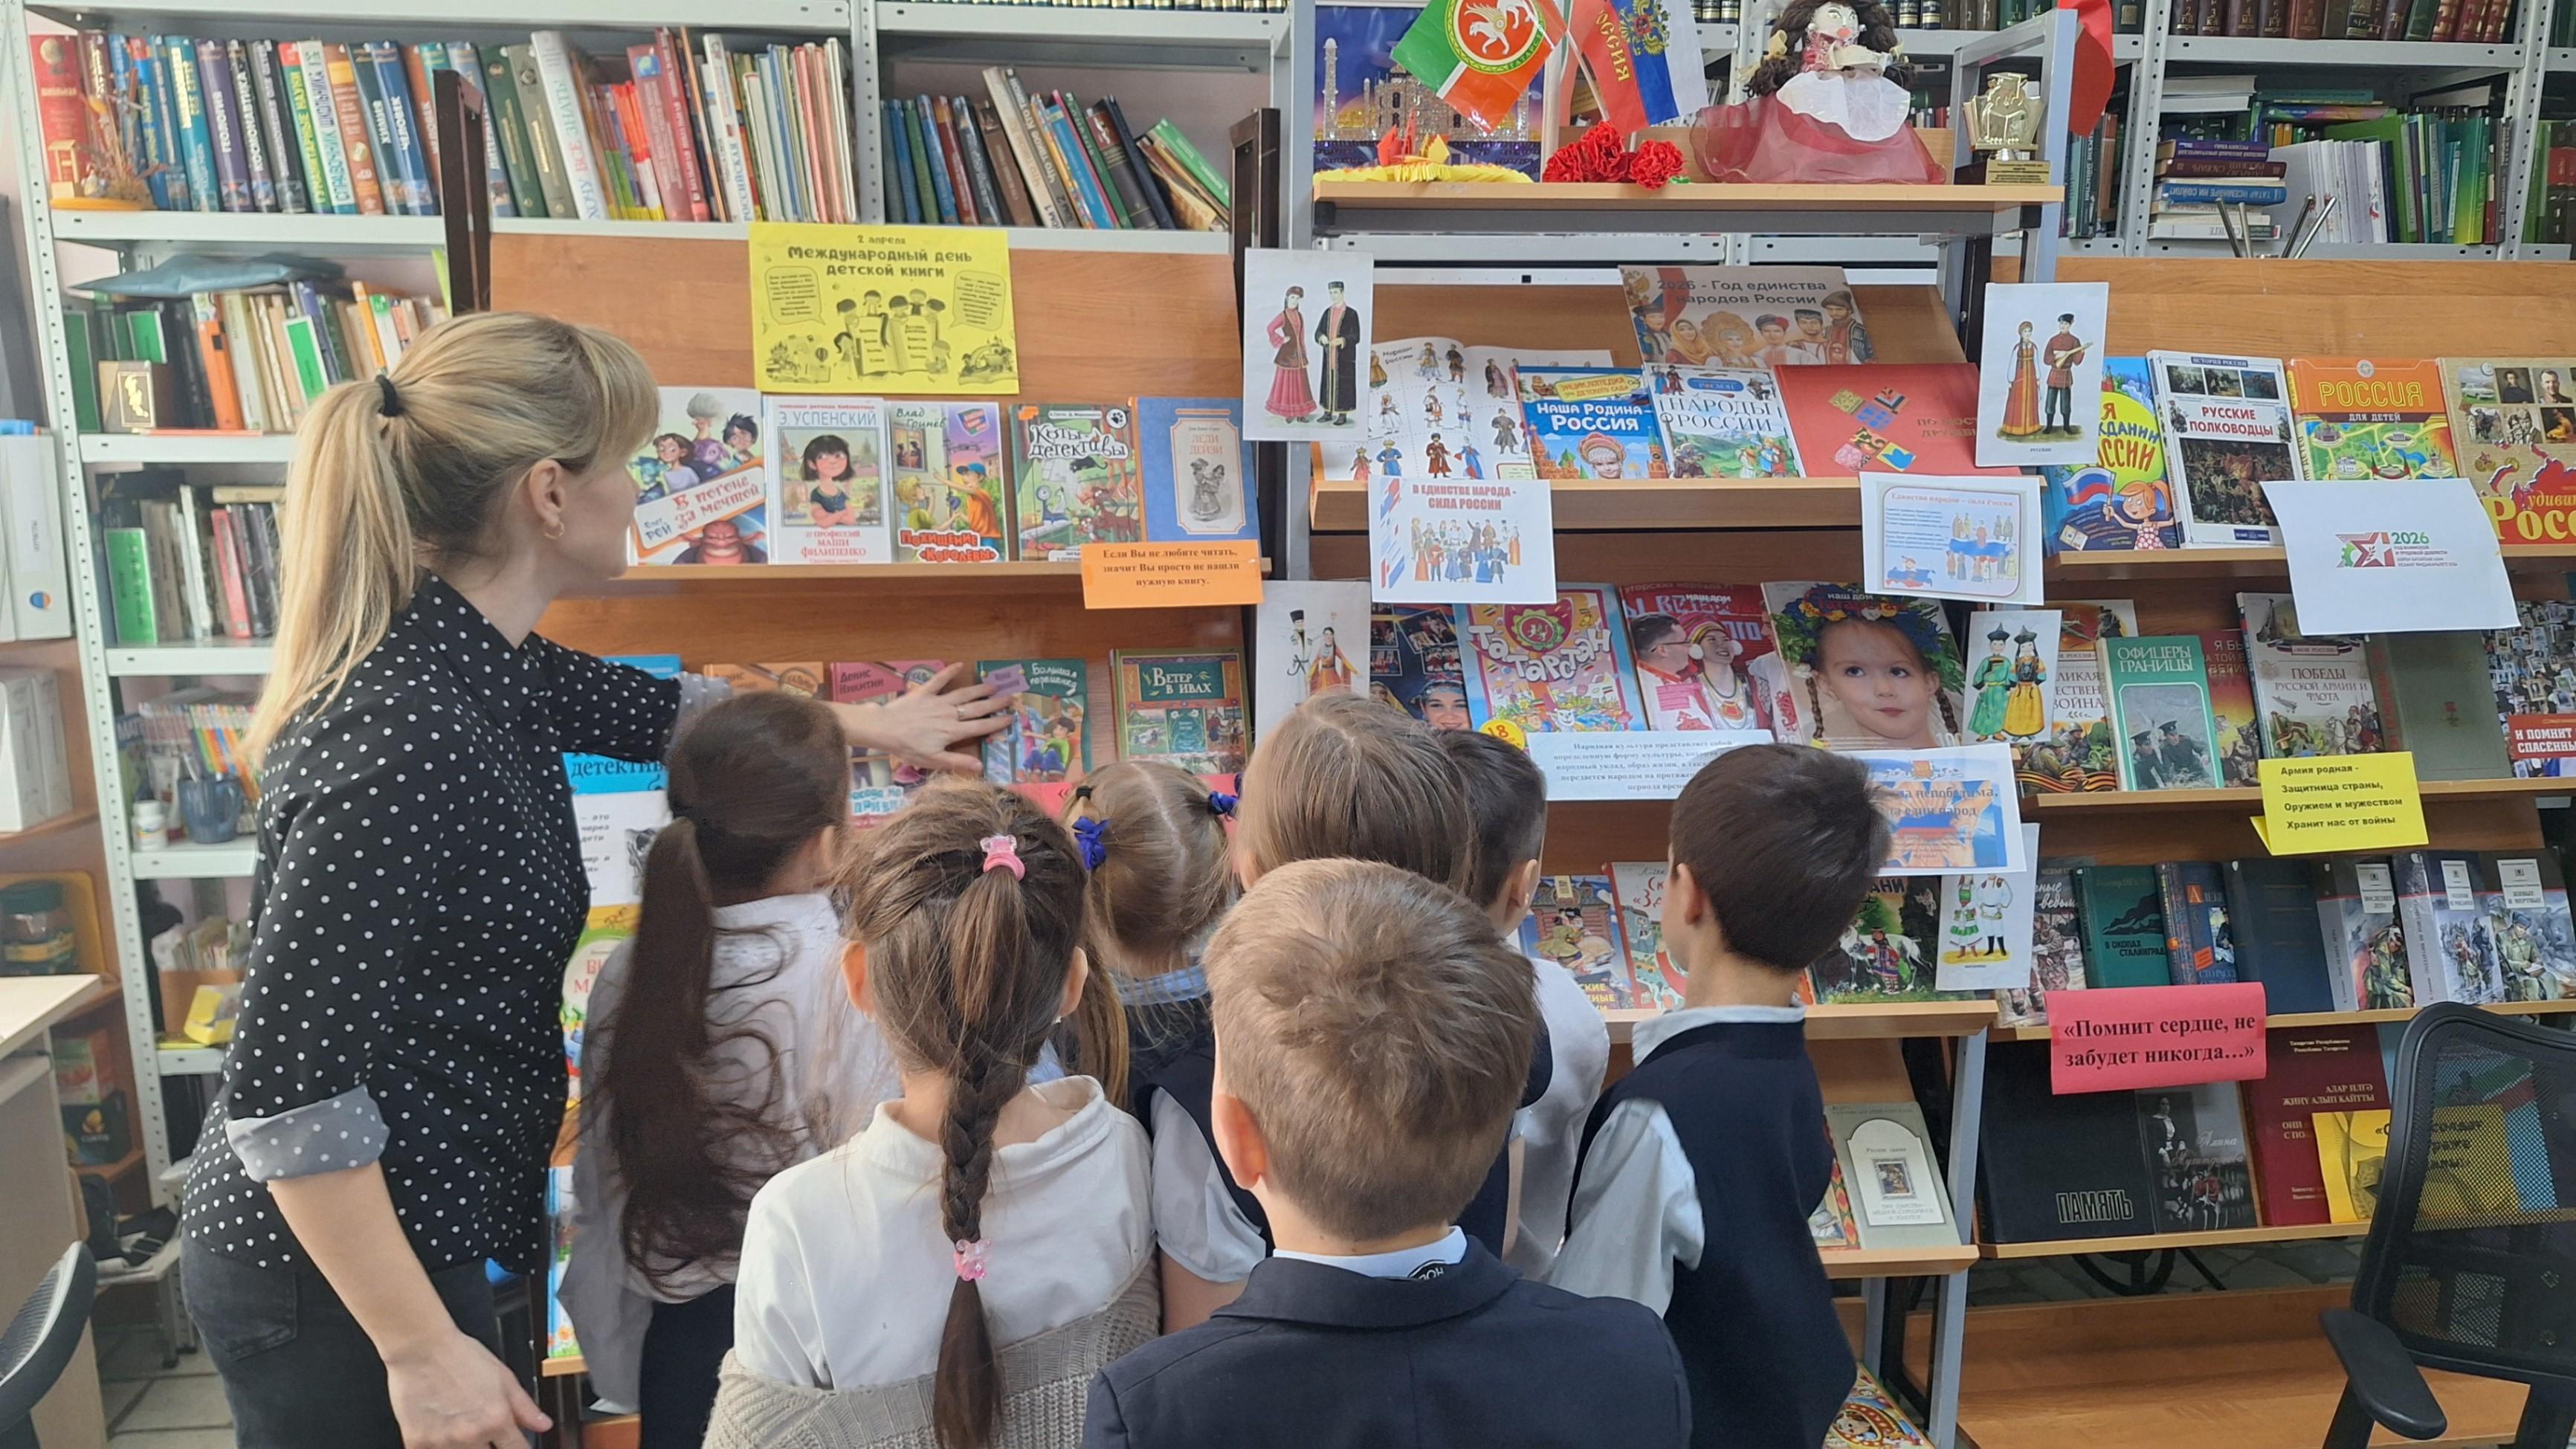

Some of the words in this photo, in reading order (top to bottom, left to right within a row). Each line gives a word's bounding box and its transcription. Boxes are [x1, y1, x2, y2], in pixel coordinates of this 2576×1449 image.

[290, 71, 309, 110] НАУКИ
[1009, 77, 1024, 109] такой
[213, 90, 233, 154] ГЕОЛОГИЯ
[237, 71, 265, 172] КОСМОНАВТИКА
[372, 99, 392, 144] ХИМИЯ
[391, 95, 411, 150] ЧЕЛОВЕК
[1022, 107, 1034, 130] Кто
[1031, 129, 1046, 161] такое
[323, 130, 350, 201] СПРАВОЧНИК
[1044, 161, 1056, 184] Что
[1057, 194, 1064, 204] 2
[2248, 190, 2271, 199] ТАТАР
[857, 236, 865, 244] 2
[869, 236, 906, 245] апреля
[788, 247, 929, 263] Международный
[935, 251, 972, 263] день
[827, 264, 894, 277] детской
[900, 267, 945, 278] книги
[1658, 280, 1696, 291] 2026
[1711, 280, 1743, 291] Год
[1747, 282, 1827, 291] единства
[1678, 295, 1749, 306] народов
[1754, 294, 1817, 304] России
[2318, 380, 2425, 407] РОССИЯ
[897, 408, 925, 417] Влад
[1667, 398, 1772, 416] НАРОДЫ
[2102, 403, 2117, 420] Я
[2202, 407, 2256, 420] РУССКИЕ
[778, 411, 792, 425] Э.
[793, 410, 877, 426] УСПЕНСКИЙ
[906, 418, 947, 430] Гринёв
[1552, 414, 1639, 431] РОССИЯ
[1676, 413, 1772, 431] РОССИИ
[2372, 413, 2401, 422] ДЕТЕЙ
[2189, 421, 2274, 437] ПОЛКОВОДЦЫ
[1029, 433, 1127, 459] детективы
[1192, 434, 1219, 445] ЛЕДИ
[1189, 445, 1223, 456] ДЕЙЗИ
[673, 495, 690, 510] В
[695, 477, 750, 504] погоне
[1413, 485, 1419, 494] В
[1421, 485, 1471, 496] ЕДИНСТВЕ
[1472, 487, 1511, 497] НАРОДА
[701, 485, 761, 517] мечтой
[1428, 498, 1457, 509] СИЛА
[1459, 498, 1502, 510] РОССИИ
[817, 539, 850, 547] МАШИ
[2392, 532, 2430, 544] 2026
[801, 547, 867, 558] ФИЛИПЕНКО
[1103, 550, 1127, 558] Если
[1130, 549, 1145, 558] Вы
[1162, 549, 1198, 558] любите
[1201, 549, 1238, 558] читать,
[1103, 565, 1137, 573] значит
[1139, 564, 1155, 573] Вы
[1158, 564, 1191, 575] просто
[1206, 562, 1240, 571] нашли
[1136, 578, 1175, 587] нужную
[1178, 577, 1210, 587] книгу.
[2117, 645, 2192, 660] ОФИЦЕРЫ
[2214, 640, 2224, 651] Я
[1031, 662, 1077, 679] Большая
[2120, 659, 2194, 673] ГРАНИЦЫ
[839, 669, 873, 684] Денис
[1152, 667, 1193, 687] ВЕТЕР
[2292, 668, 2346, 680] ПОБЕДЫ
[839, 678, 885, 695] Никитин
[1166, 684, 1174, 694] В
[1178, 682, 1212, 694] ИВАХ
[2275, 681, 2320, 691] РУССКОЙ
[2323, 682, 2357, 691] АРМИИ
[2360, 682, 2368, 691] И
[2307, 691, 2340, 702] ФЛОТА
[2515, 730, 2523, 740] И
[2526, 728, 2572, 740] ПОМНИТ
[2281, 766, 2314, 776] Армия
[2317, 765, 2353, 775] родная
[2281, 783, 2339, 794] Защитница
[2342, 781, 2383, 791] страны,
[1937, 805, 1978, 818] народ
[2285, 801, 2332, 812] Оружием
[2345, 797, 2403, 810] мужеством
[2287, 819, 2324, 830] Хранит
[2363, 816, 2395, 825] войны
[2064, 1019, 2154, 1039] «Помнит
[2159, 1018, 2229, 1039] сердце,
[2234, 1017, 2256, 1030] не
[2065, 1049, 2140, 1071] забудет
[2325, 1085, 2349, 1094] АЛАР
[2311, 1097, 2337, 1105] АЛЫП
[2338, 1093, 2375, 1103] КАЙТТЫ
[2056, 1190, 2134, 1224] ПАМЯТЬ
